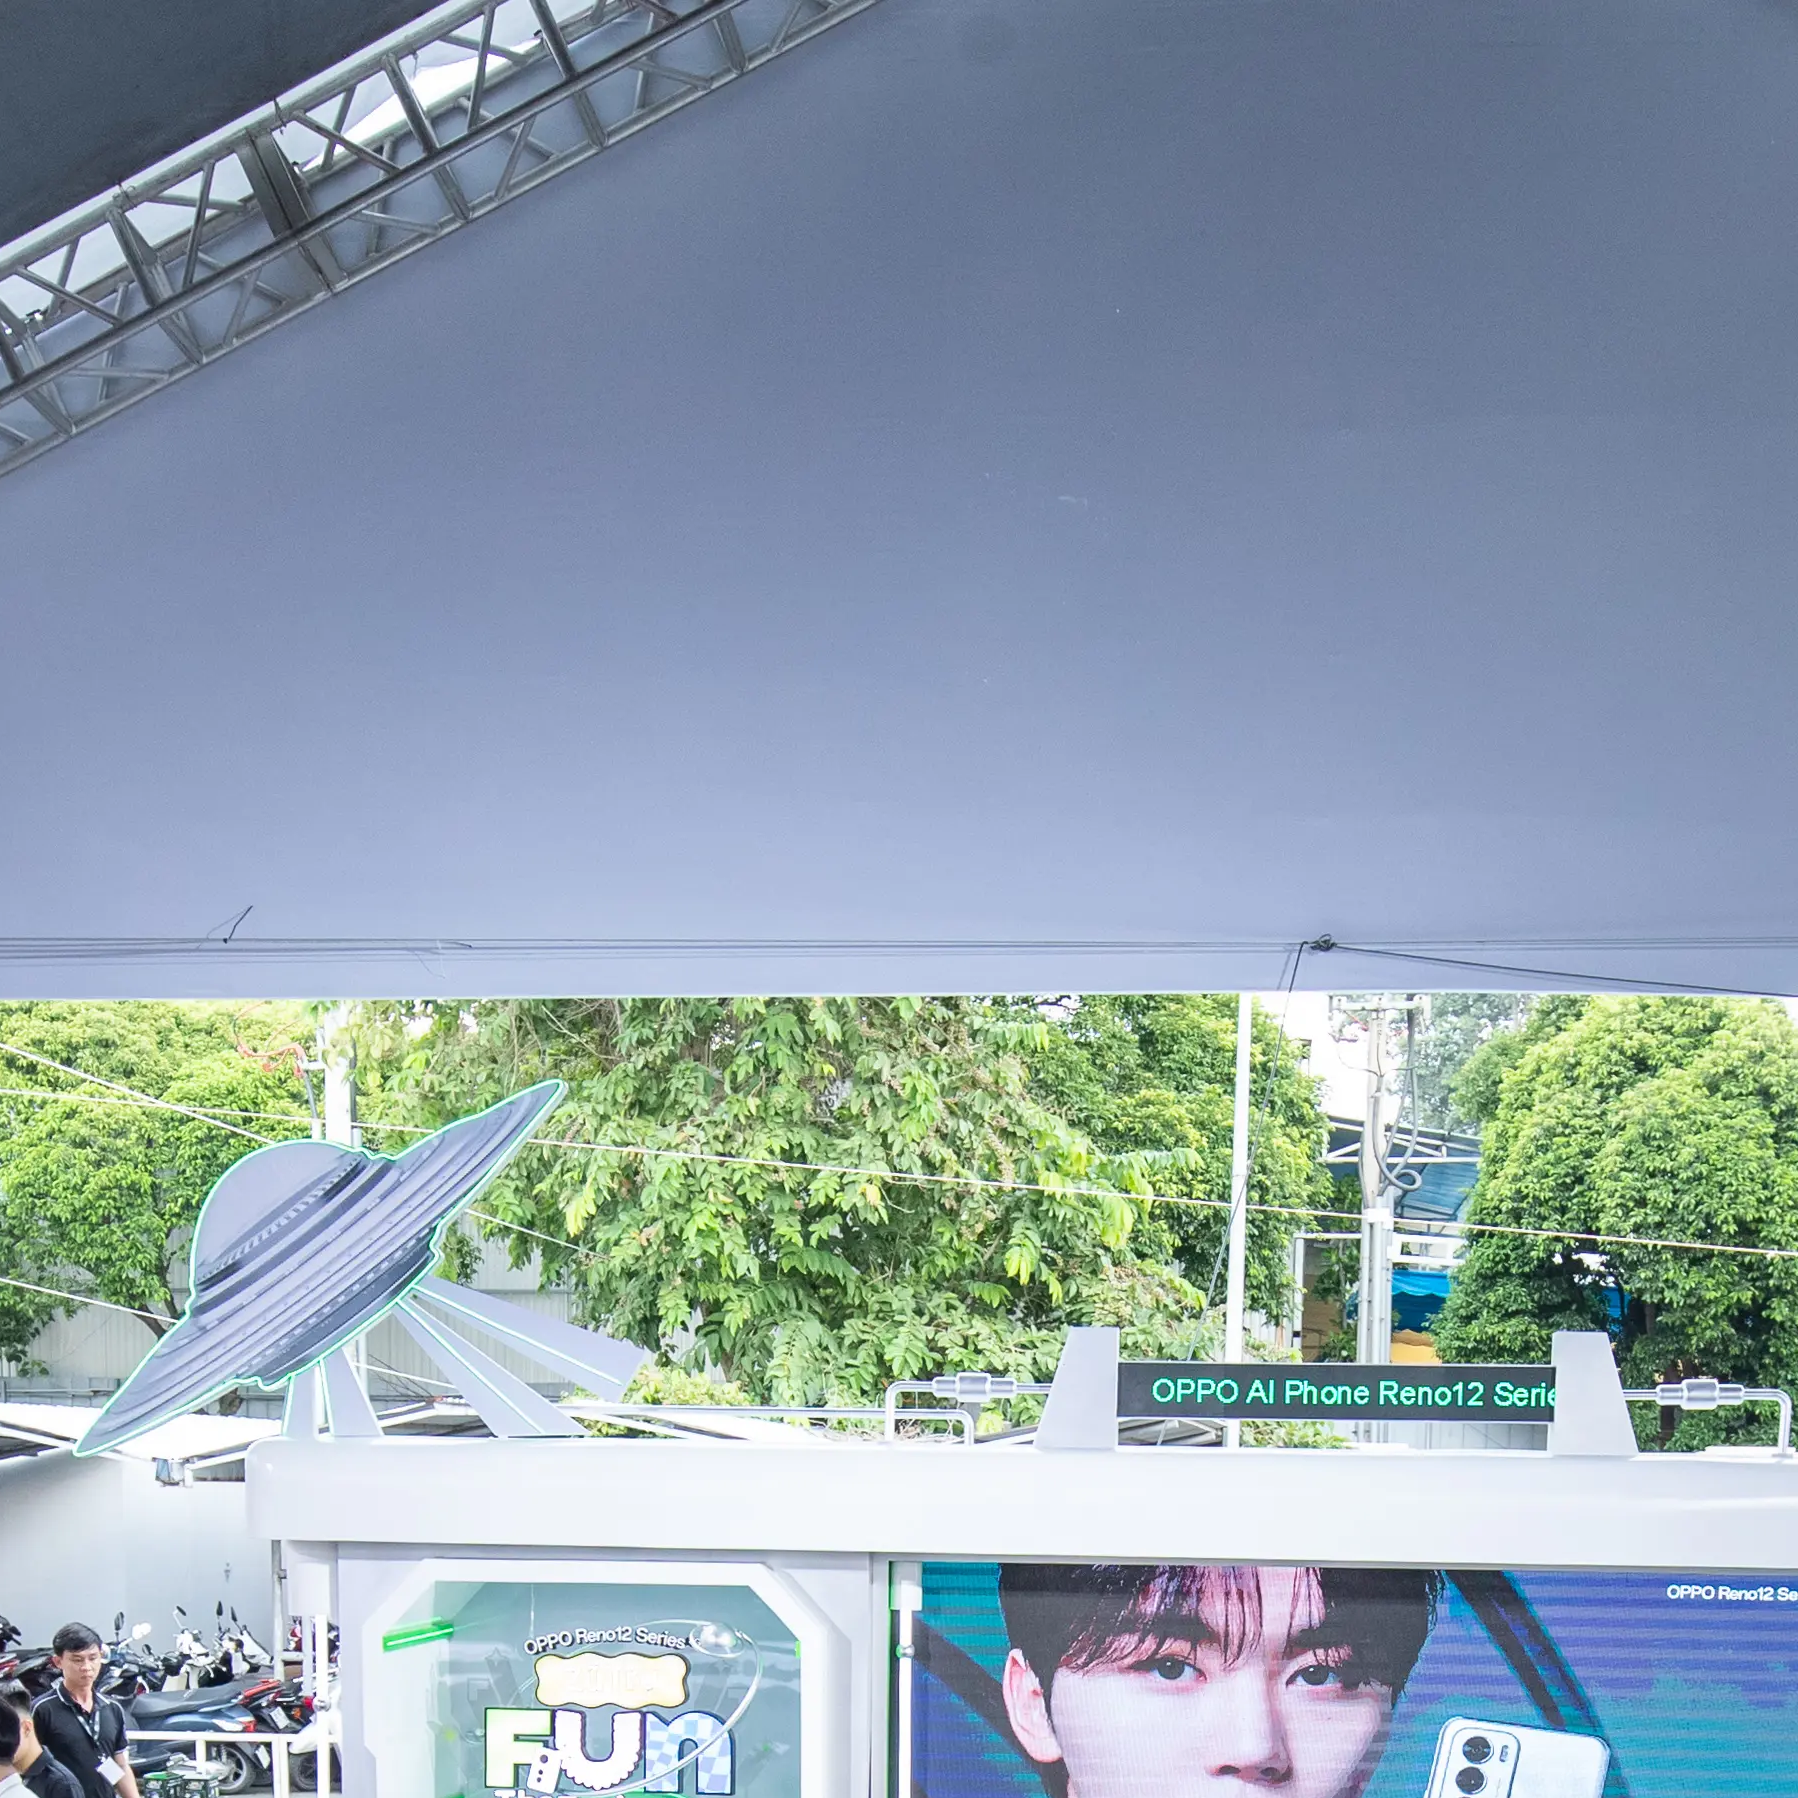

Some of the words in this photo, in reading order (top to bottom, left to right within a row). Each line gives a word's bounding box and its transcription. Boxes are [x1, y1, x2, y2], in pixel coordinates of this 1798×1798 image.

[1152, 1378, 1238, 1403] OPPO
[1246, 1380, 1274, 1404] AI
[1285, 1380, 1369, 1405] Phone
[1379, 1381, 1483, 1407] Reno12
[1667, 1585, 1714, 1599] OPPO
[1718, 1586, 1773, 1601] Reno12
[524, 1630, 572, 1654] OPPO
[575, 1626, 633, 1644] Reno12
[635, 1626, 685, 1649] Series
